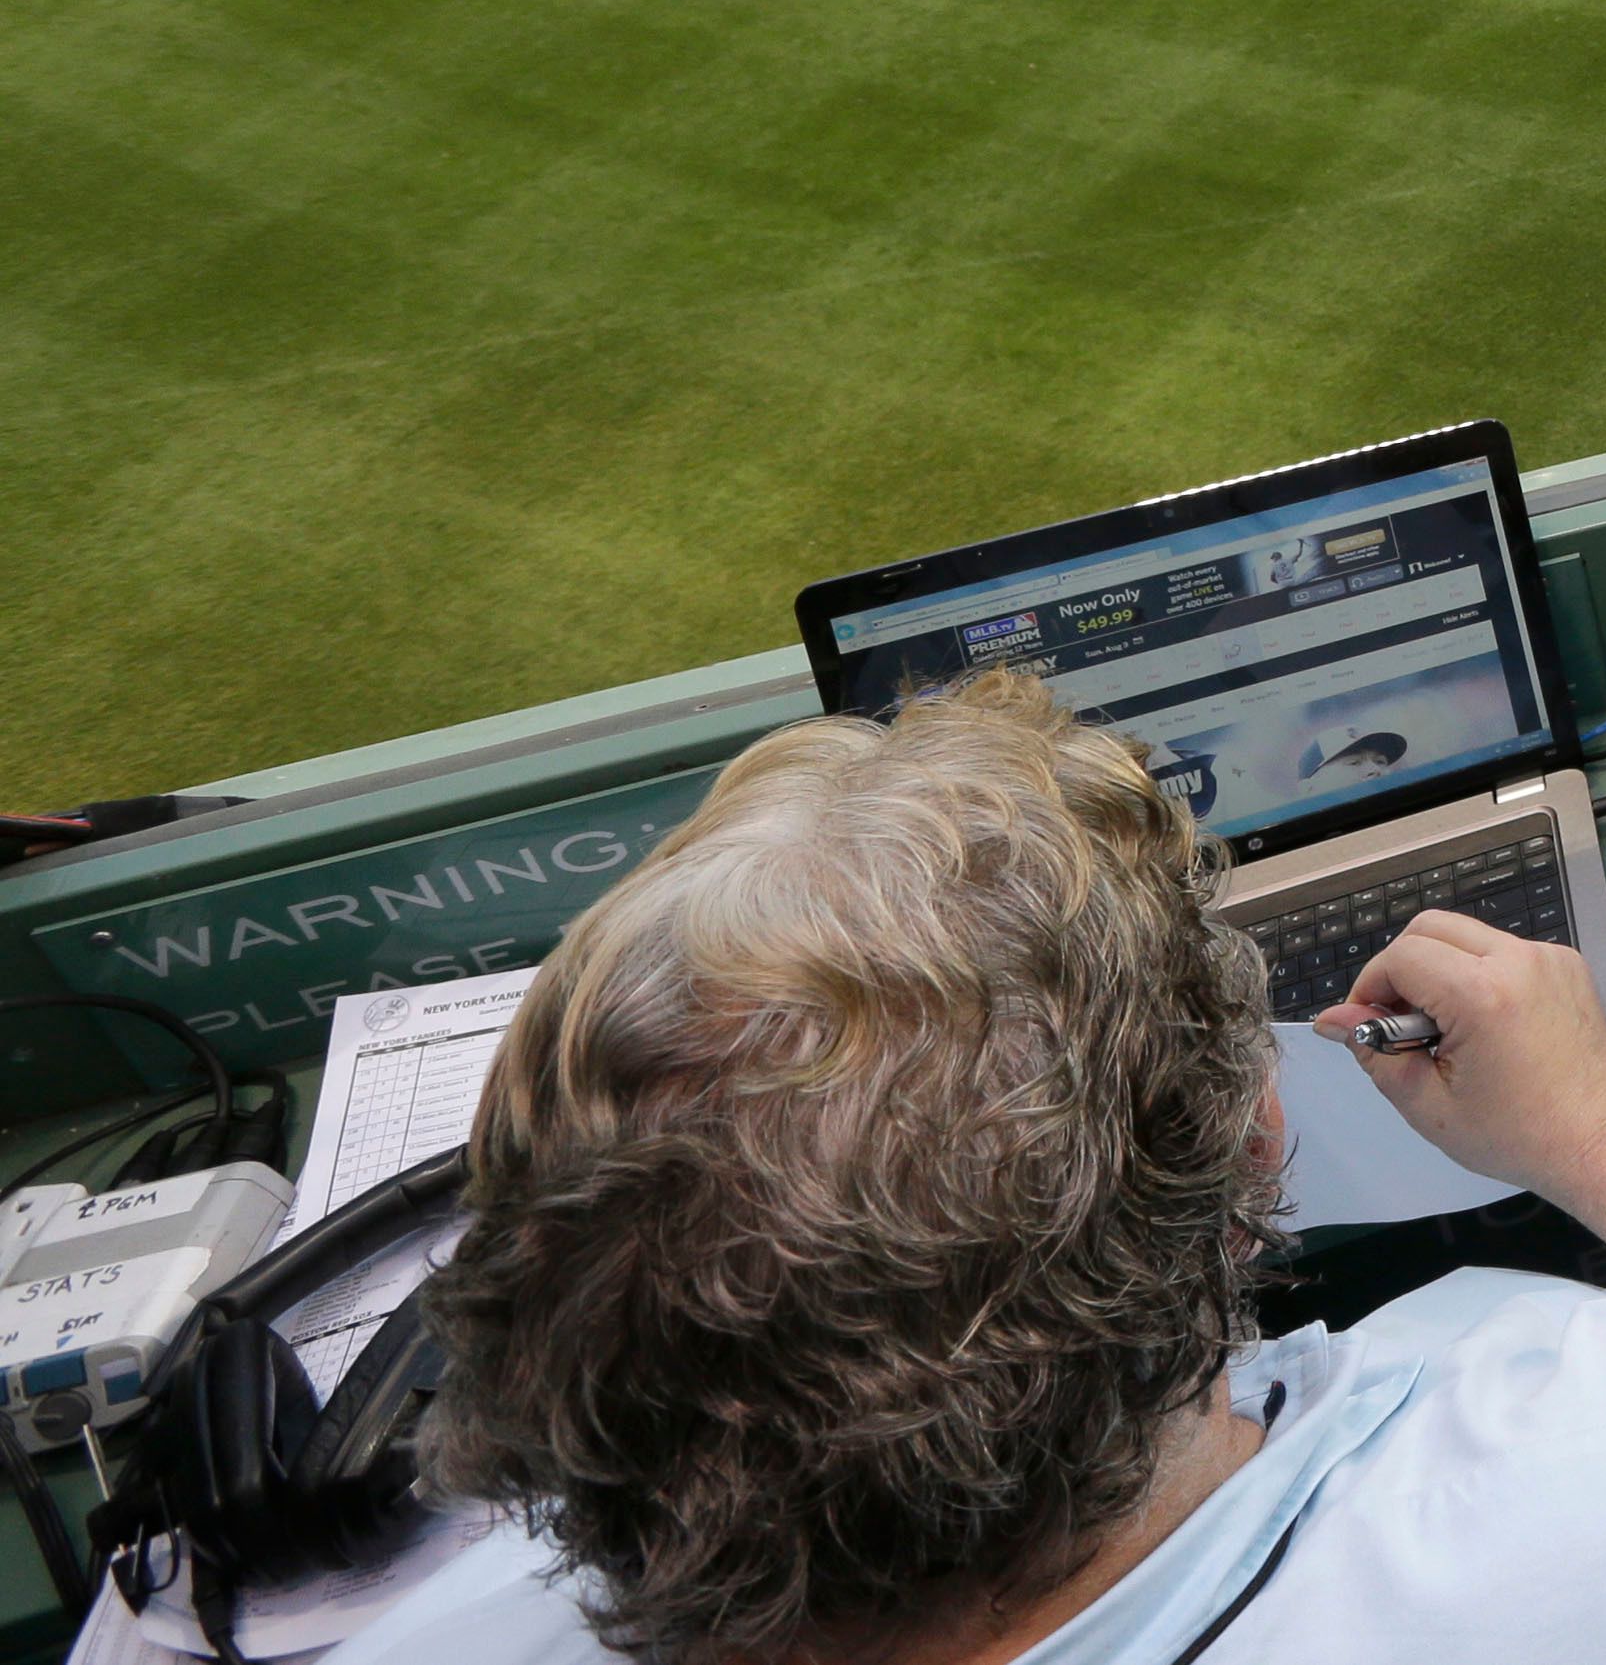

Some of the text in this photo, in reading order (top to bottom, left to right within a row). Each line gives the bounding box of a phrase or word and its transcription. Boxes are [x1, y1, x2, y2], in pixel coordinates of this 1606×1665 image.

[1167, 574, 1223, 594] out-of-market
[1168, 565, 1218, 583] Watch every
[1185, 599, 1203, 610] 400
[1203, 591, 1234, 605] devices
[1193, 586, 1213, 598] LIVE
[1213, 583, 1225, 593] on
[1058, 588, 1141, 619] Now Only
[1077, 608, 1134, 635] $49.99
[968, 627, 1042, 656] PREMIUM
[423, 1003, 452, 1016] NEW
[453, 999, 487, 1011] YORK
[358, 1027, 452, 1051] NEW YORK YANKEES
[101, 1191, 157, 1216] PGM
[57, 1312, 104, 1334] STAT
[290, 1310, 374, 1342] BOSTON RED SOX
